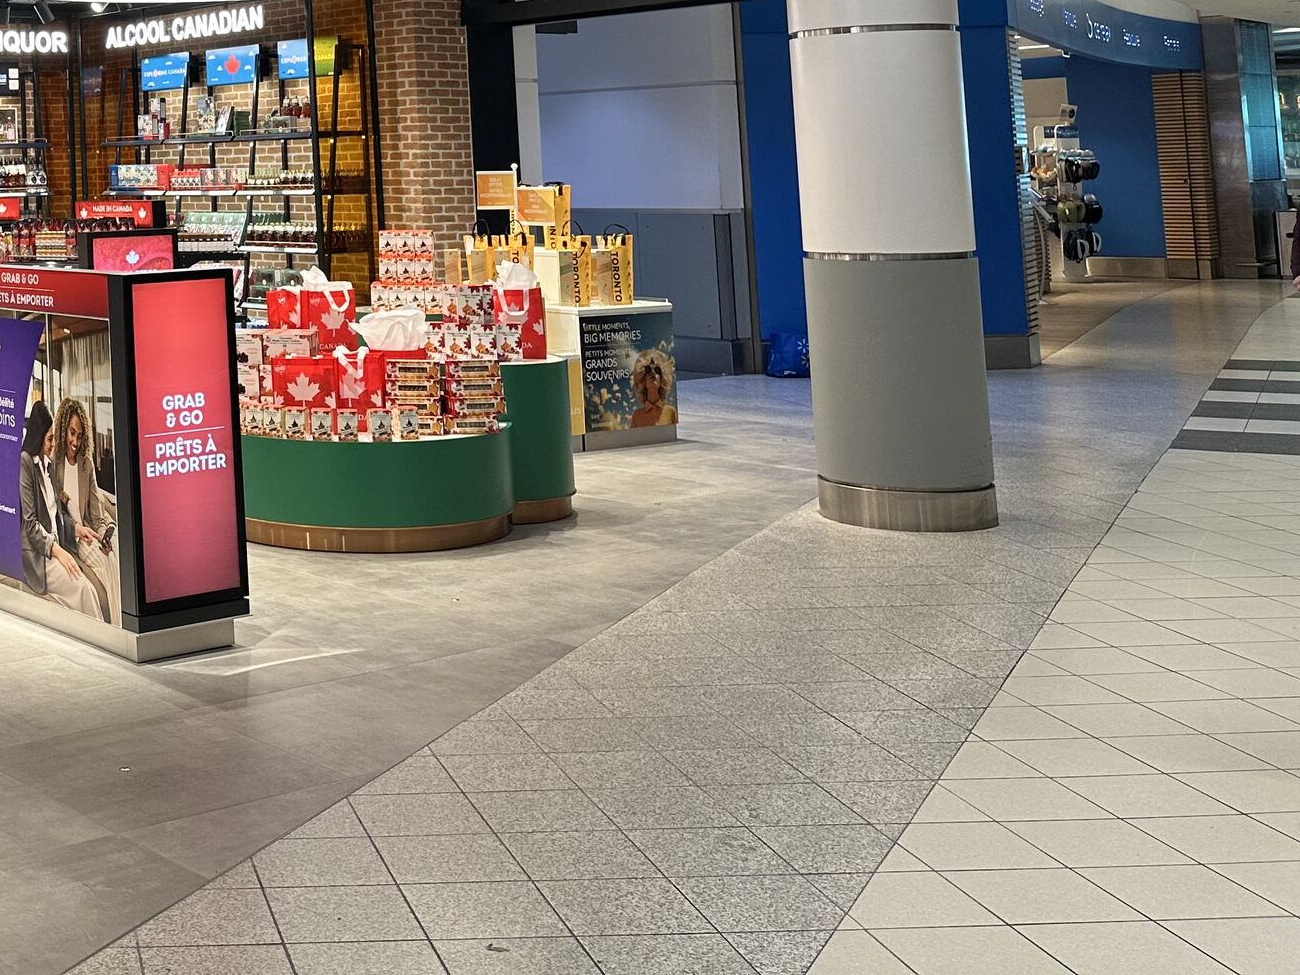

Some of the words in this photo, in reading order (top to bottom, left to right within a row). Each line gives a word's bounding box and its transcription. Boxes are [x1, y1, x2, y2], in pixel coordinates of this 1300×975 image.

[105, 20, 171, 49] ALCOOL
[171, 4, 264, 42] CANADIAN
[1, 272, 20, 284] GRAB
[21, 273, 27, 284] &
[27, 274, 39, 285] GO
[610, 251, 622, 302] TORONTO
[9, 290, 16, 304] À
[16, 293, 54, 308] EMPORTER
[584, 333, 598, 344] BIG
[599, 330, 642, 343] MEMORIES
[585, 350, 604, 358] PETITS
[585, 357, 618, 370] GRANDS
[586, 369, 630, 382] SOUVENIRS
[162, 392, 205, 411] GRAB
[166, 412, 177, 428] &
[179, 409, 204, 426] GO
[155, 436, 203, 459] PRÊTS
[205, 432, 217, 453] À
[146, 453, 227, 478] EMPORTER
